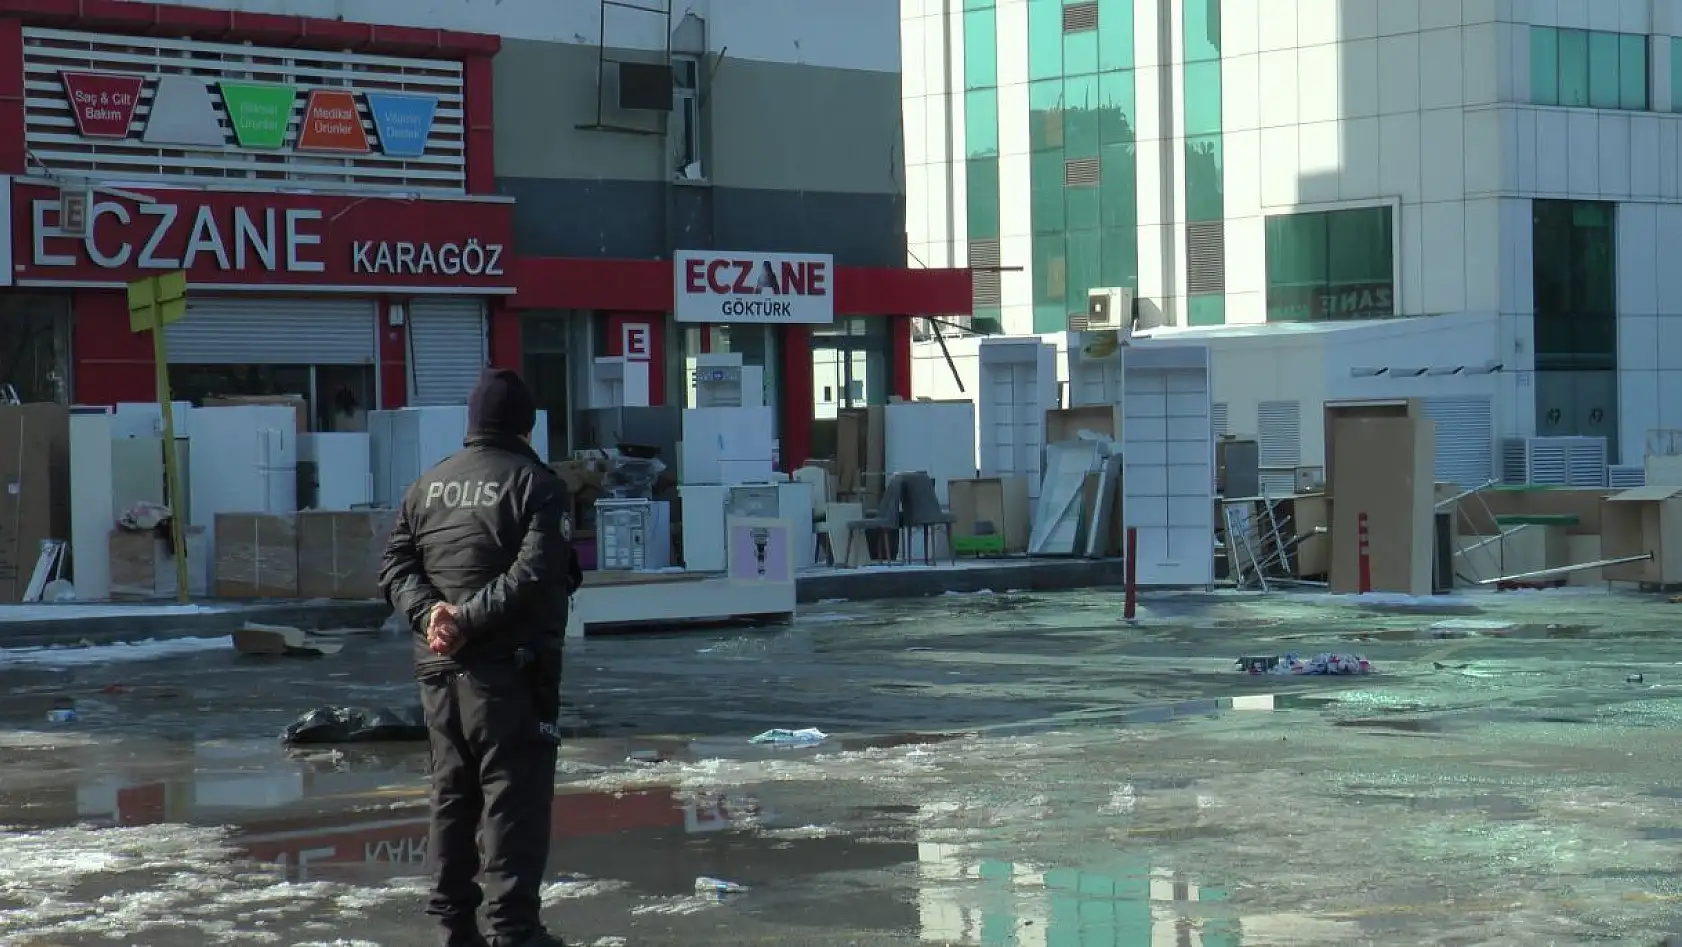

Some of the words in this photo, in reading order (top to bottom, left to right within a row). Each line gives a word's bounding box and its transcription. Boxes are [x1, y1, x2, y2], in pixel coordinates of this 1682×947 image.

[100, 92, 108, 106] &
[313, 107, 352, 120] Medikal
[32, 198, 325, 273] ECZANE
[352, 238, 504, 276] KARAGÖZ
[685, 258, 827, 296] ECZANE
[721, 297, 792, 317] GÖKTÜRK
[628, 329, 646, 354] E
